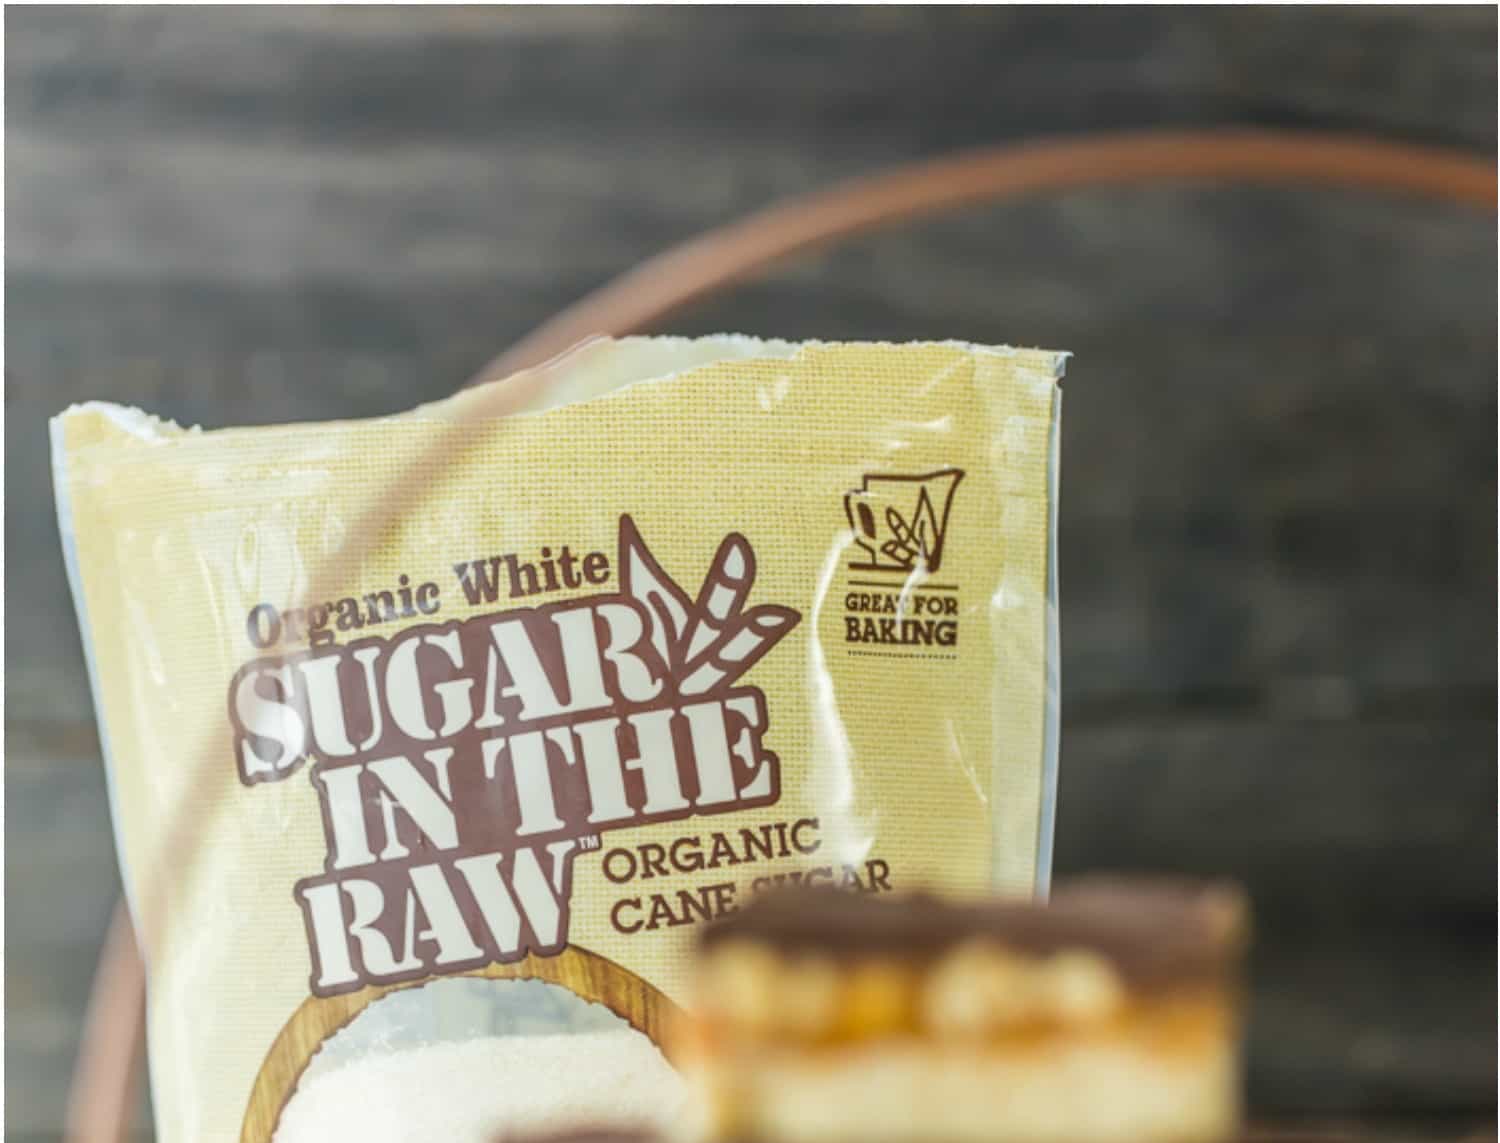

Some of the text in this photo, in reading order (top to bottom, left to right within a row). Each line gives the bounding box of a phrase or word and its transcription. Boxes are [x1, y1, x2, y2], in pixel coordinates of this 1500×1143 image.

[247, 546, 611, 650] Organic White
[844, 616, 958, 647] BAKING
[913, 594, 959, 616] FOR
[235, 602, 664, 778] SUGAR
[317, 697, 773, 872] IN THE
[602, 818, 822, 884] ORGANIC
[302, 839, 580, 989] RAW
[610, 882, 741, 934] CANE
